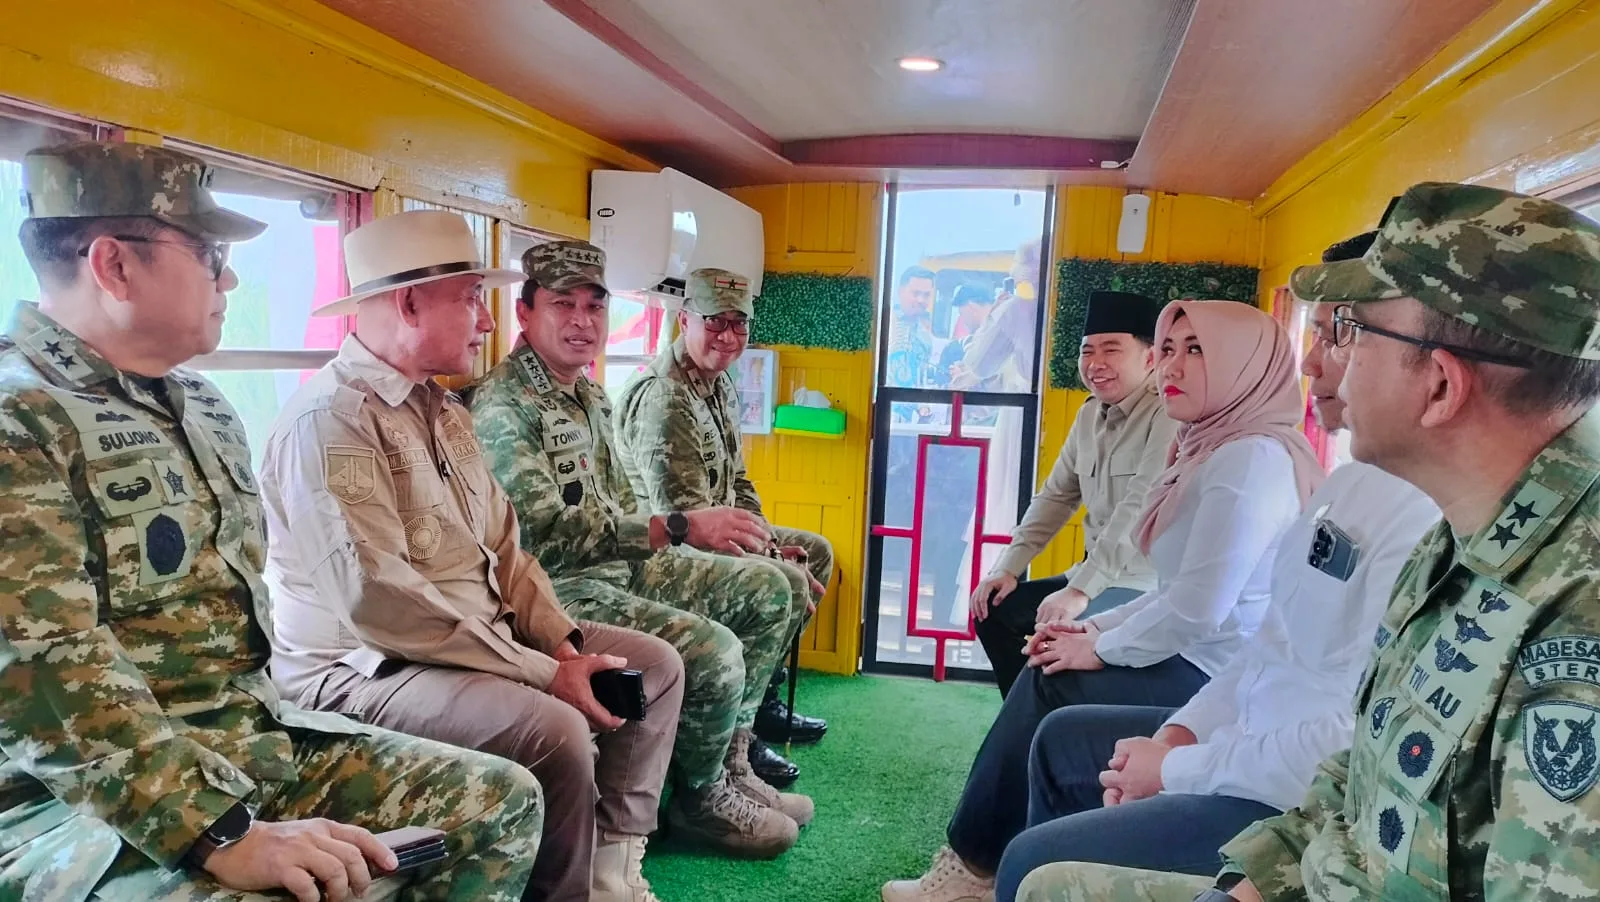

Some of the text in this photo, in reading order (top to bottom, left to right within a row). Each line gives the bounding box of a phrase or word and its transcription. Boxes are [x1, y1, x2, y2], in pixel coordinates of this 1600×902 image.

[551, 430, 583, 447] TONNY
[1534, 662, 1599, 682] STER
[1425, 686, 1462, 718] AU
